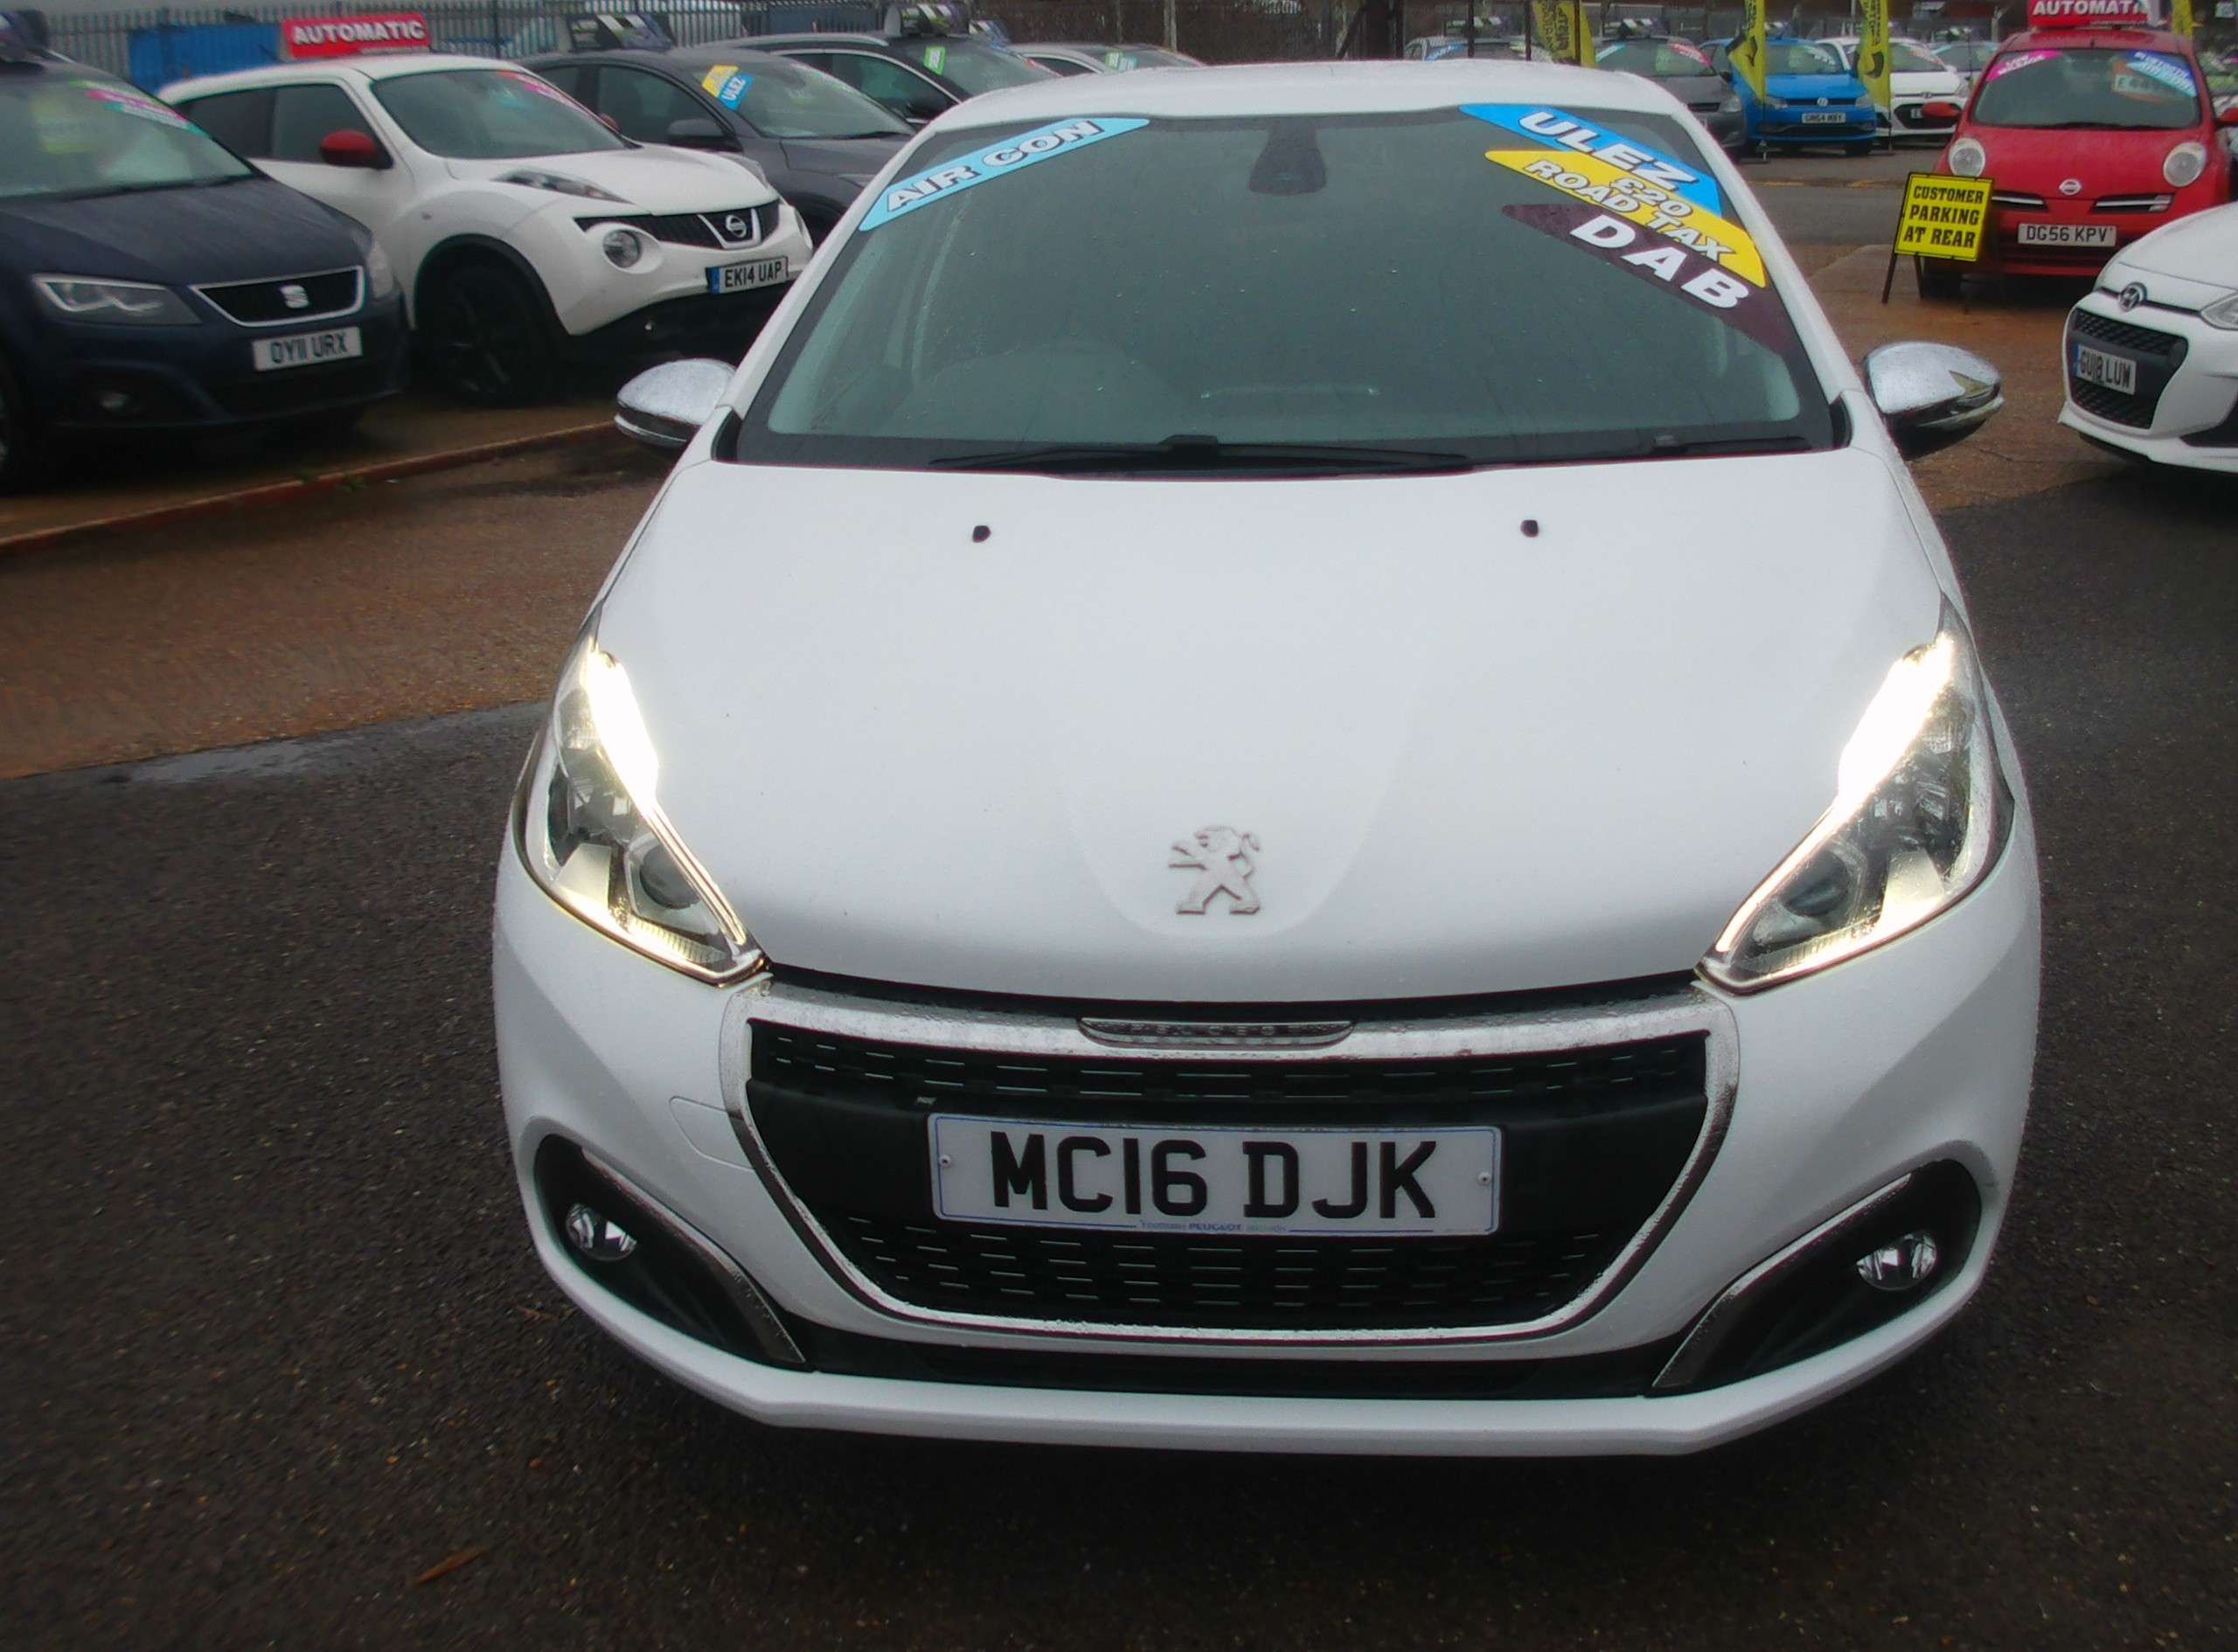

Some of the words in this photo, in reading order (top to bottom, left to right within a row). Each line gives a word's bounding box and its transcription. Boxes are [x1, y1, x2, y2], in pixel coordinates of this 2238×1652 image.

[292, 19, 426, 45] AUTOMATIC
[886, 165, 981, 212] AIR
[982, 119, 1105, 167] CON
[1519, 111, 1699, 192] ULEZ
[1524, 159, 1641, 213] ROAD
[1645, 210, 1736, 263] TAX
[1609, 177, 1692, 219] £20
[1913, 184, 1984, 205] CUSTOMER
[1908, 204, 1980, 226] PARKING
[1903, 226, 1927, 243] AT
[1929, 227, 1976, 248] REAR
[2026, 225, 2070, 242] DG56
[2074, 227, 2108, 243] KPV
[724, 264, 756, 288] EK14
[758, 260, 782, 282] UAP
[1569, 214, 1749, 309] DAB
[990, 1130, 1208, 1217] MC16
[1242, 1141, 1436, 1219] DJK
